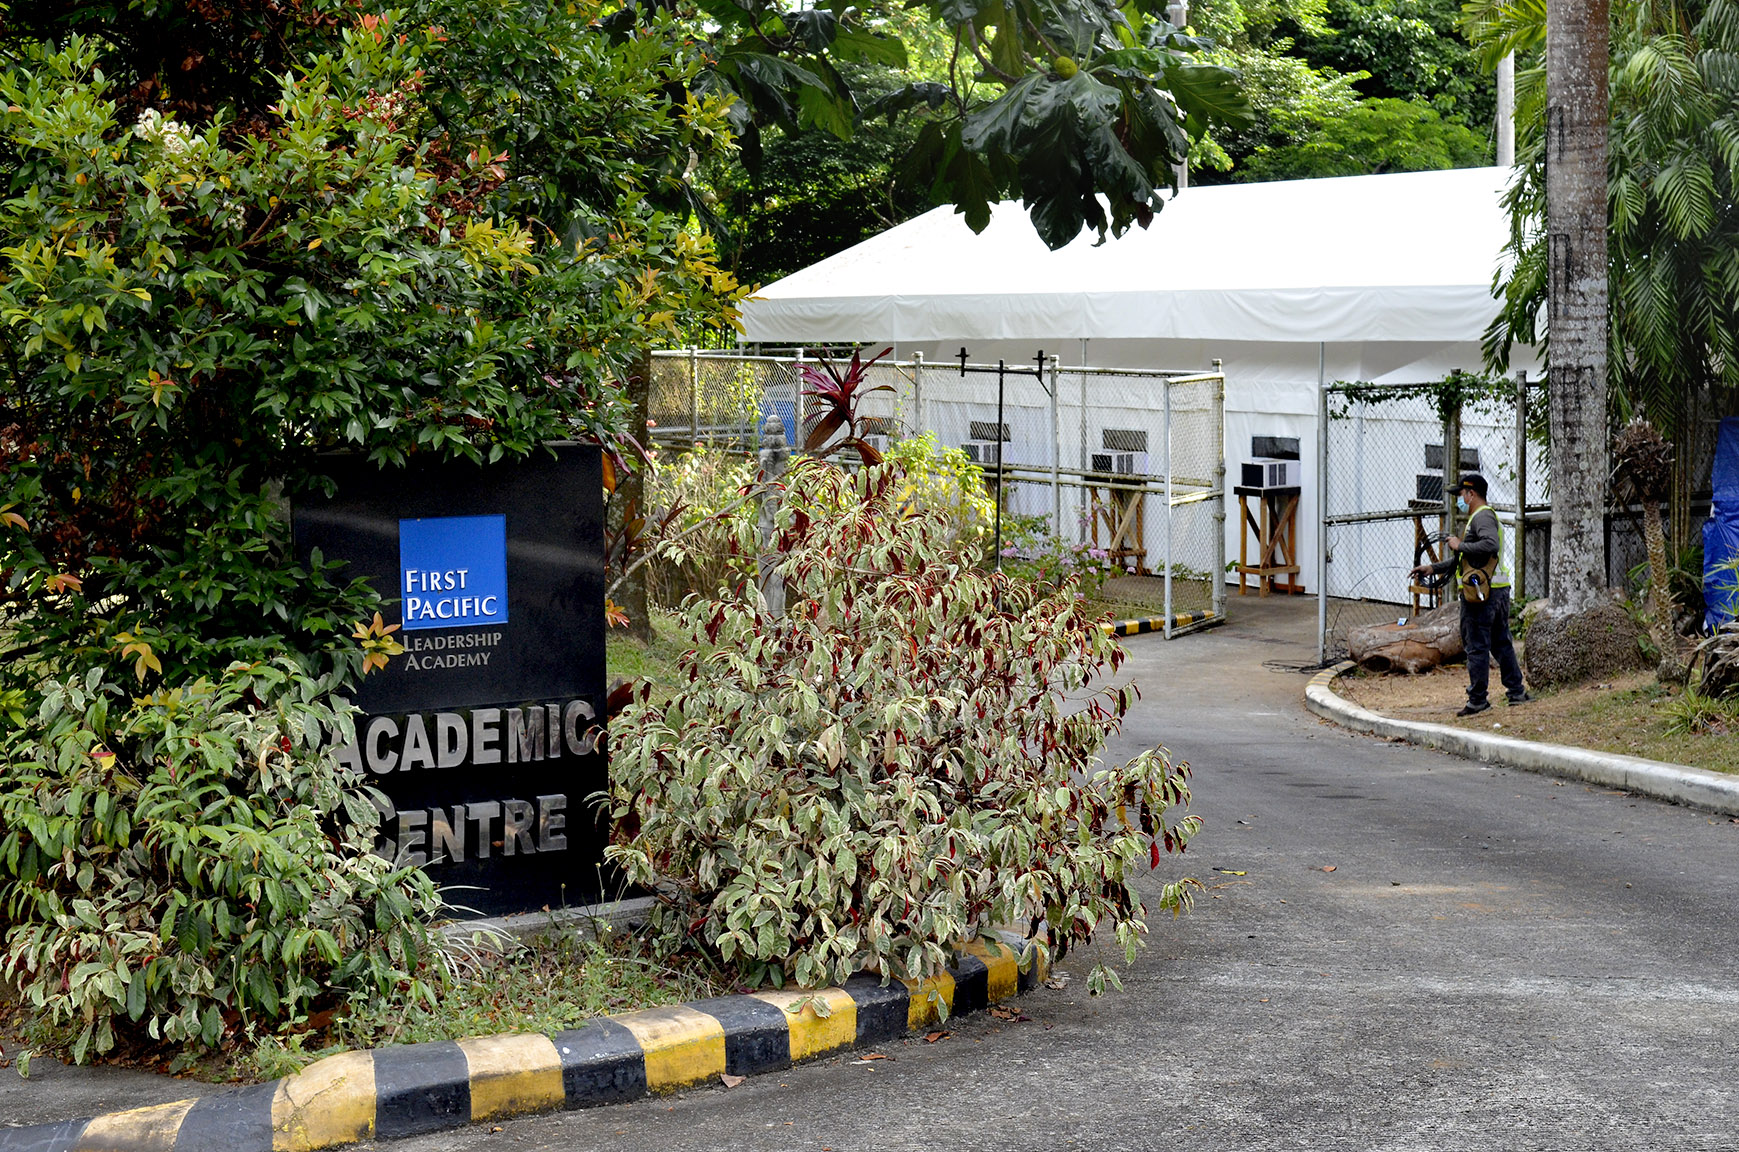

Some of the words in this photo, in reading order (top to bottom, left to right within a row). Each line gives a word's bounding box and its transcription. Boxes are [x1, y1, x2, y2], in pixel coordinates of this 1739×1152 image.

[405, 569, 468, 593] FIRST
[406, 596, 497, 620] PACIFIC
[403, 632, 502, 652] LEADERSHIP
[404, 652, 491, 671] ACADEMY
